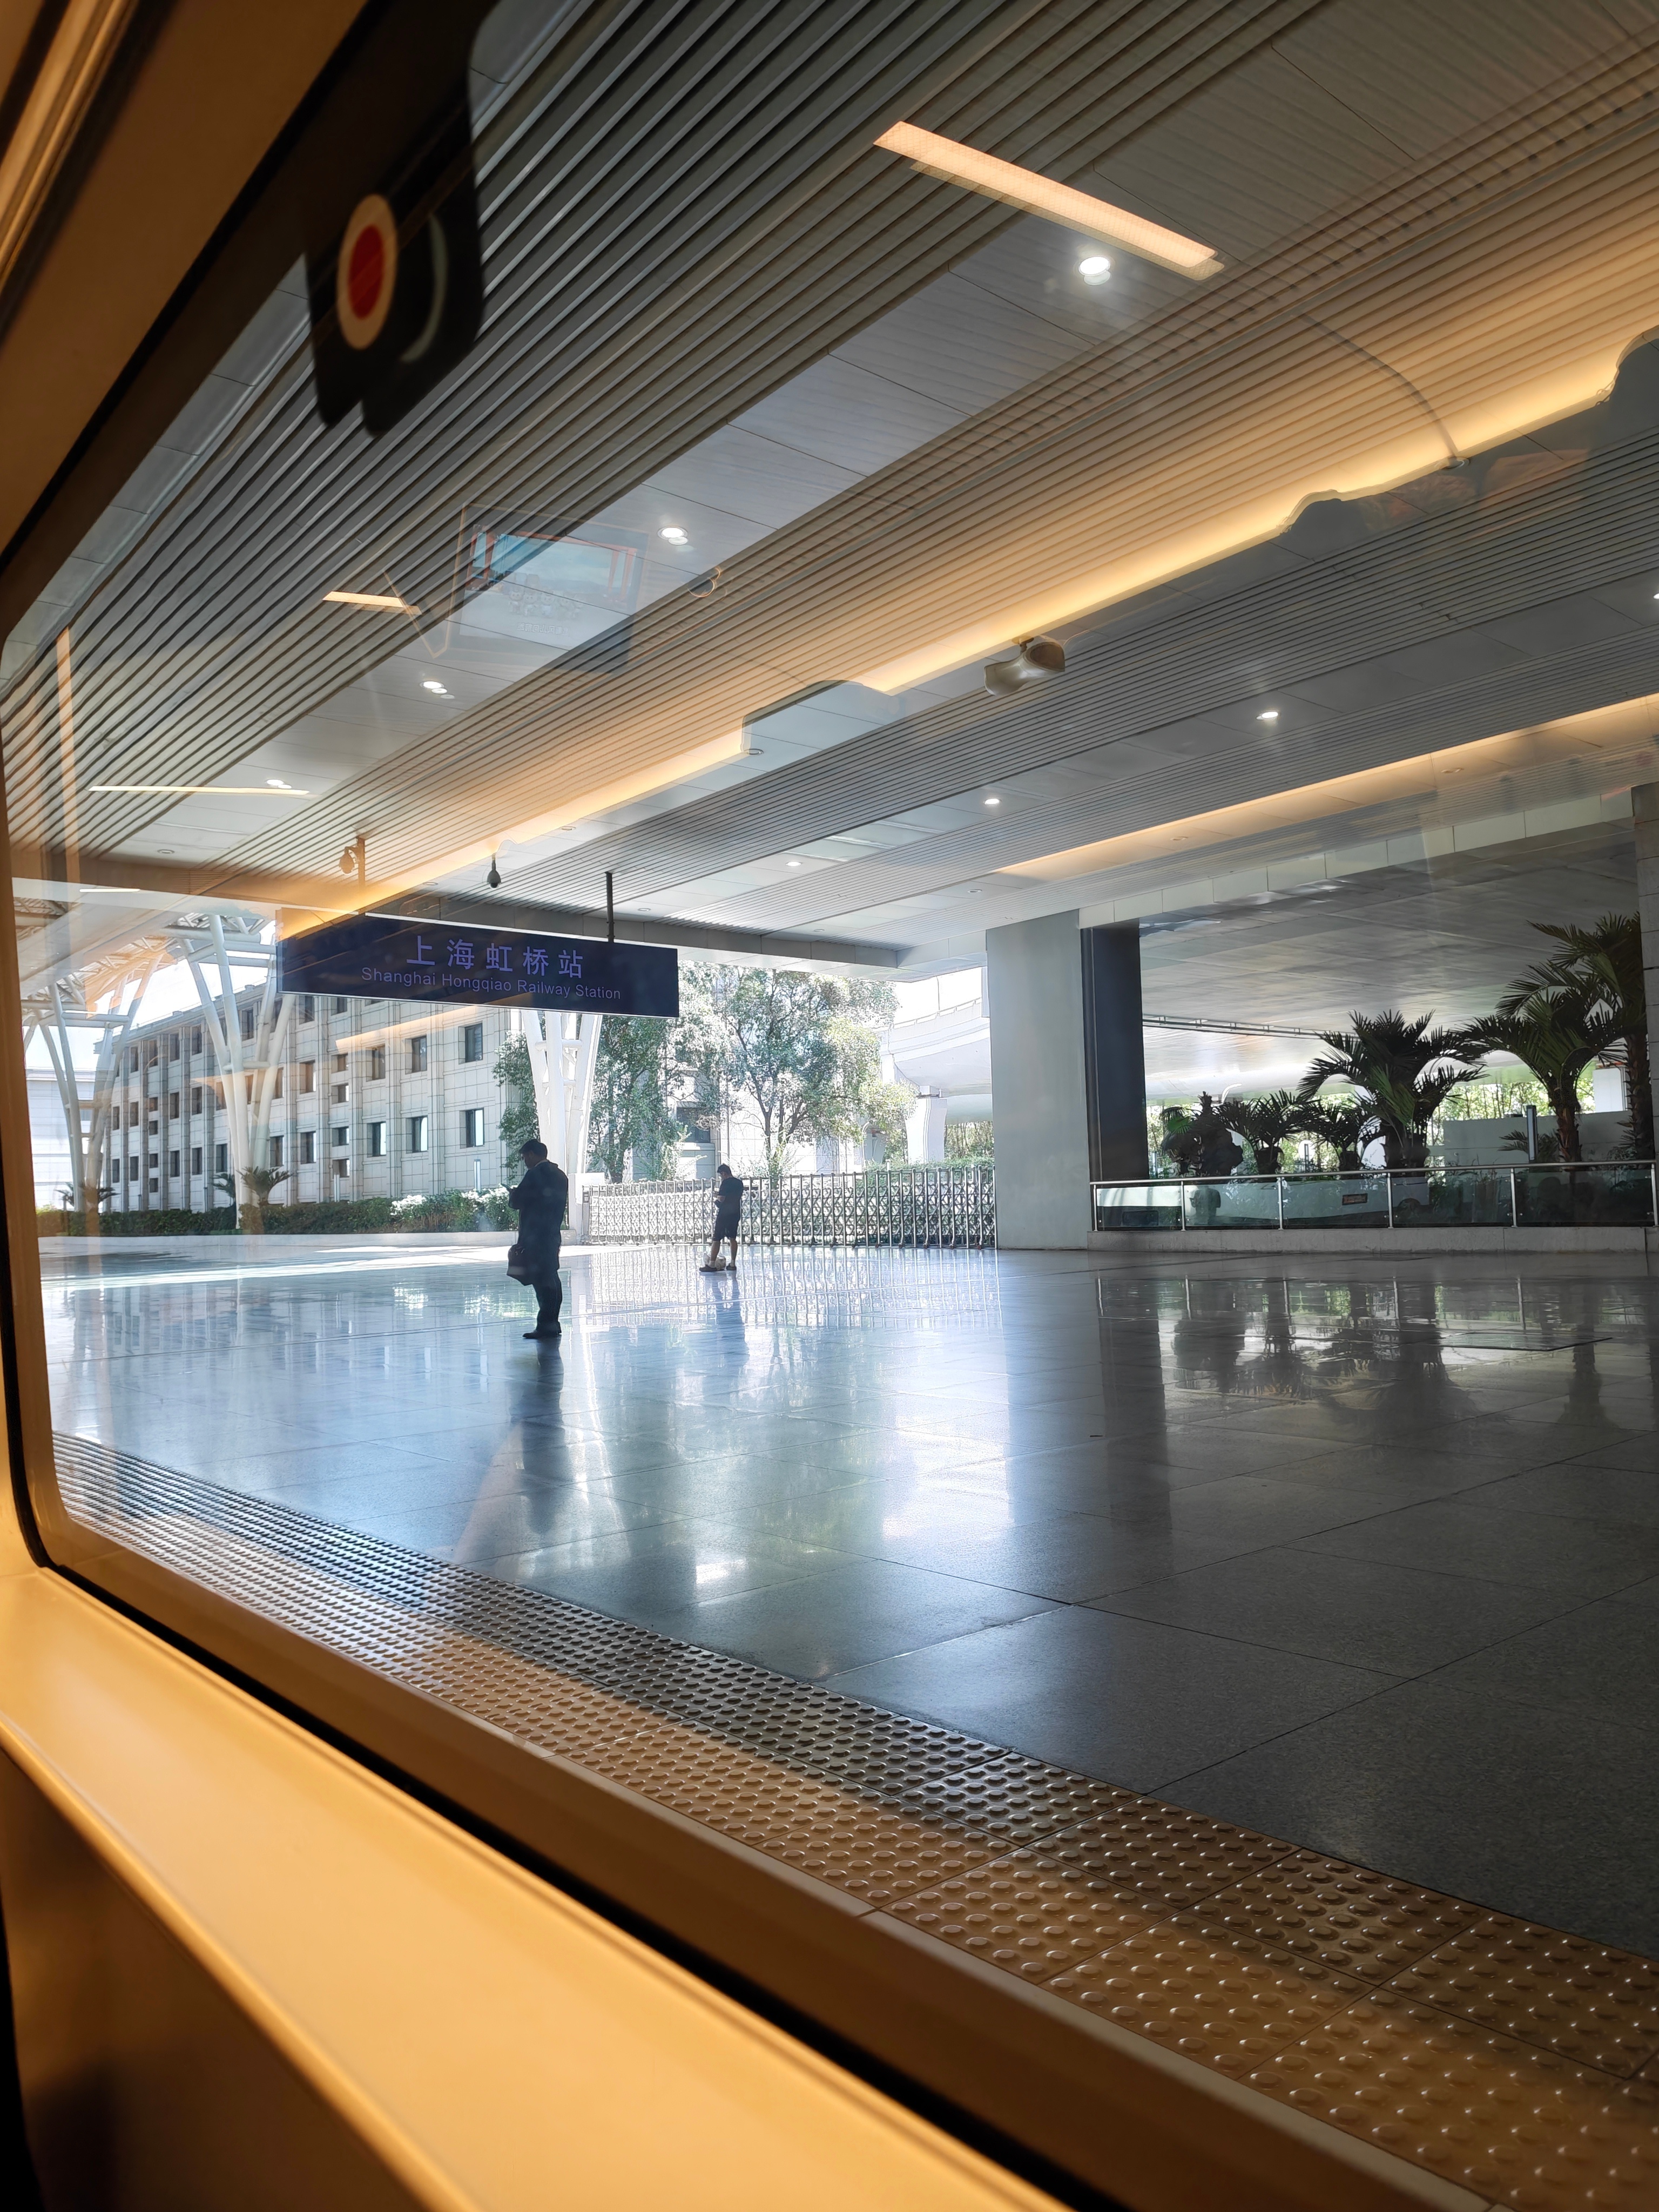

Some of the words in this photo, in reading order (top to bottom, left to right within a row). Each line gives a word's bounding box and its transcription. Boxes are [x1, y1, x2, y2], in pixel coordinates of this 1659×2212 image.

[406, 935, 583, 979] 上海虹桥站
[361, 967, 436, 987] Shanghai
[442, 973, 512, 993] Hongqiao
[517, 979, 570, 999] Railway
[575, 984, 621, 1000] Station
